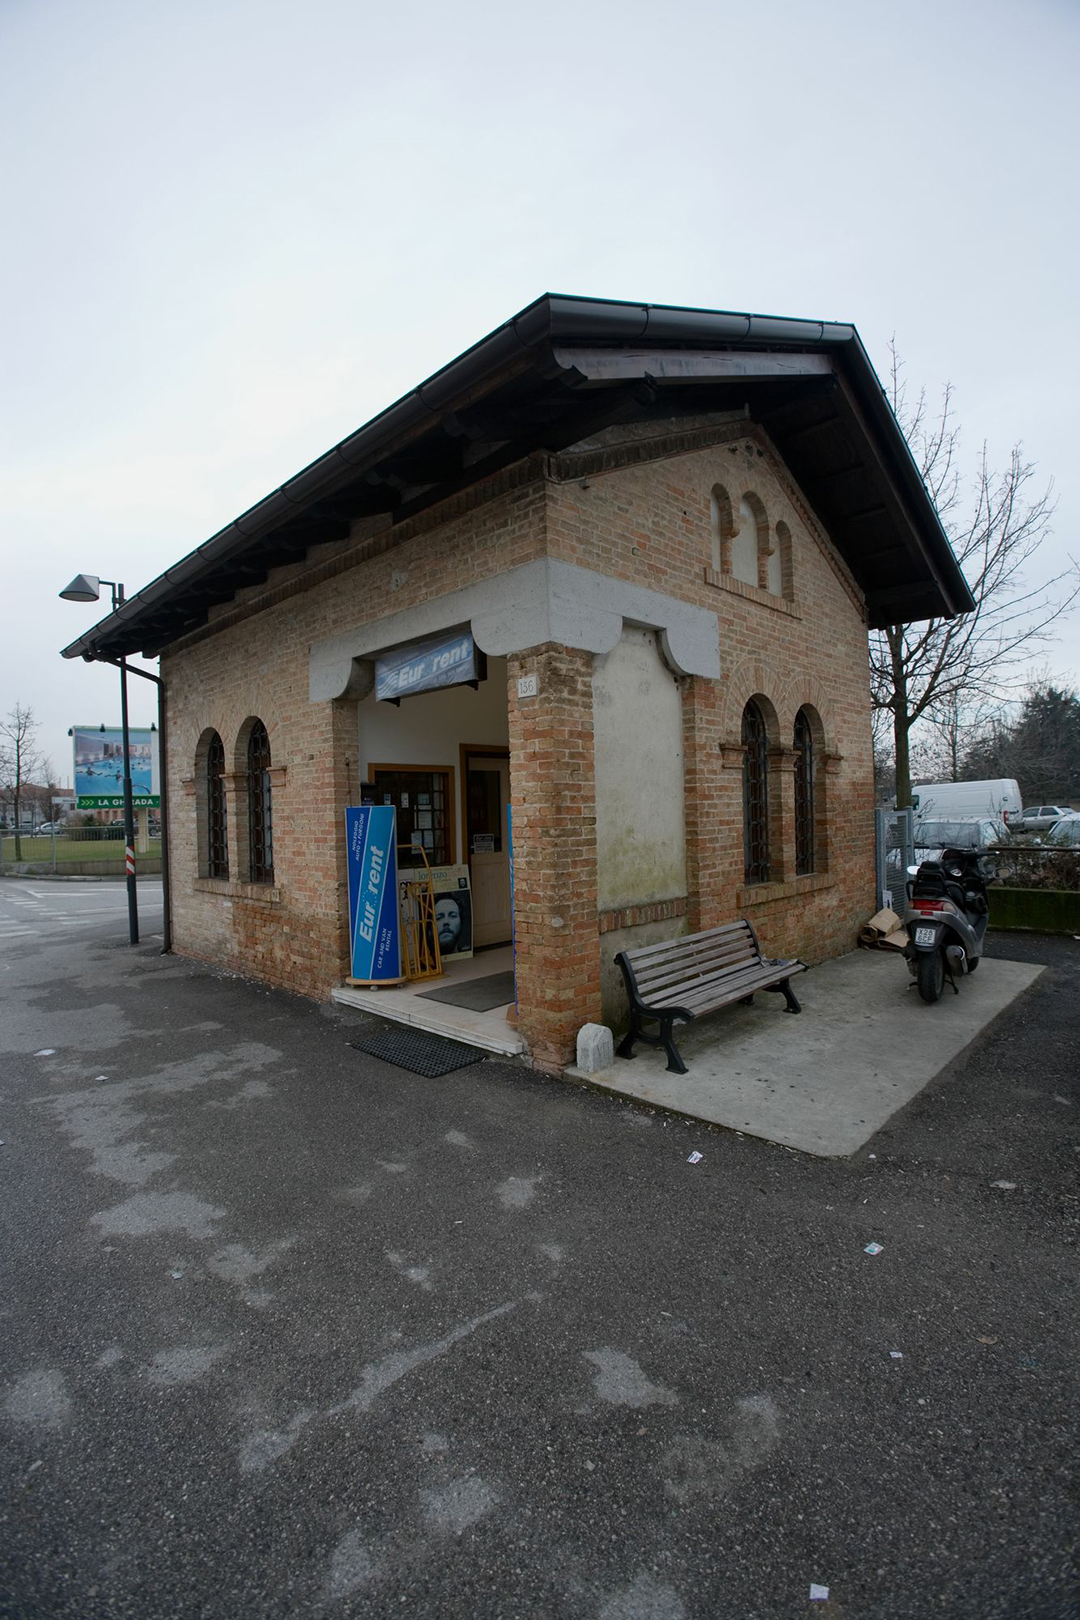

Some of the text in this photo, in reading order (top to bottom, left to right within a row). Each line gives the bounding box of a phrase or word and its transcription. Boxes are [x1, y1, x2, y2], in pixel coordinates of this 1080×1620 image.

[520, 680, 534, 694] 136
[112, 798, 153, 806] GHADA
[357, 813, 365, 840] FURGONI
[368, 845, 384, 894] rent
